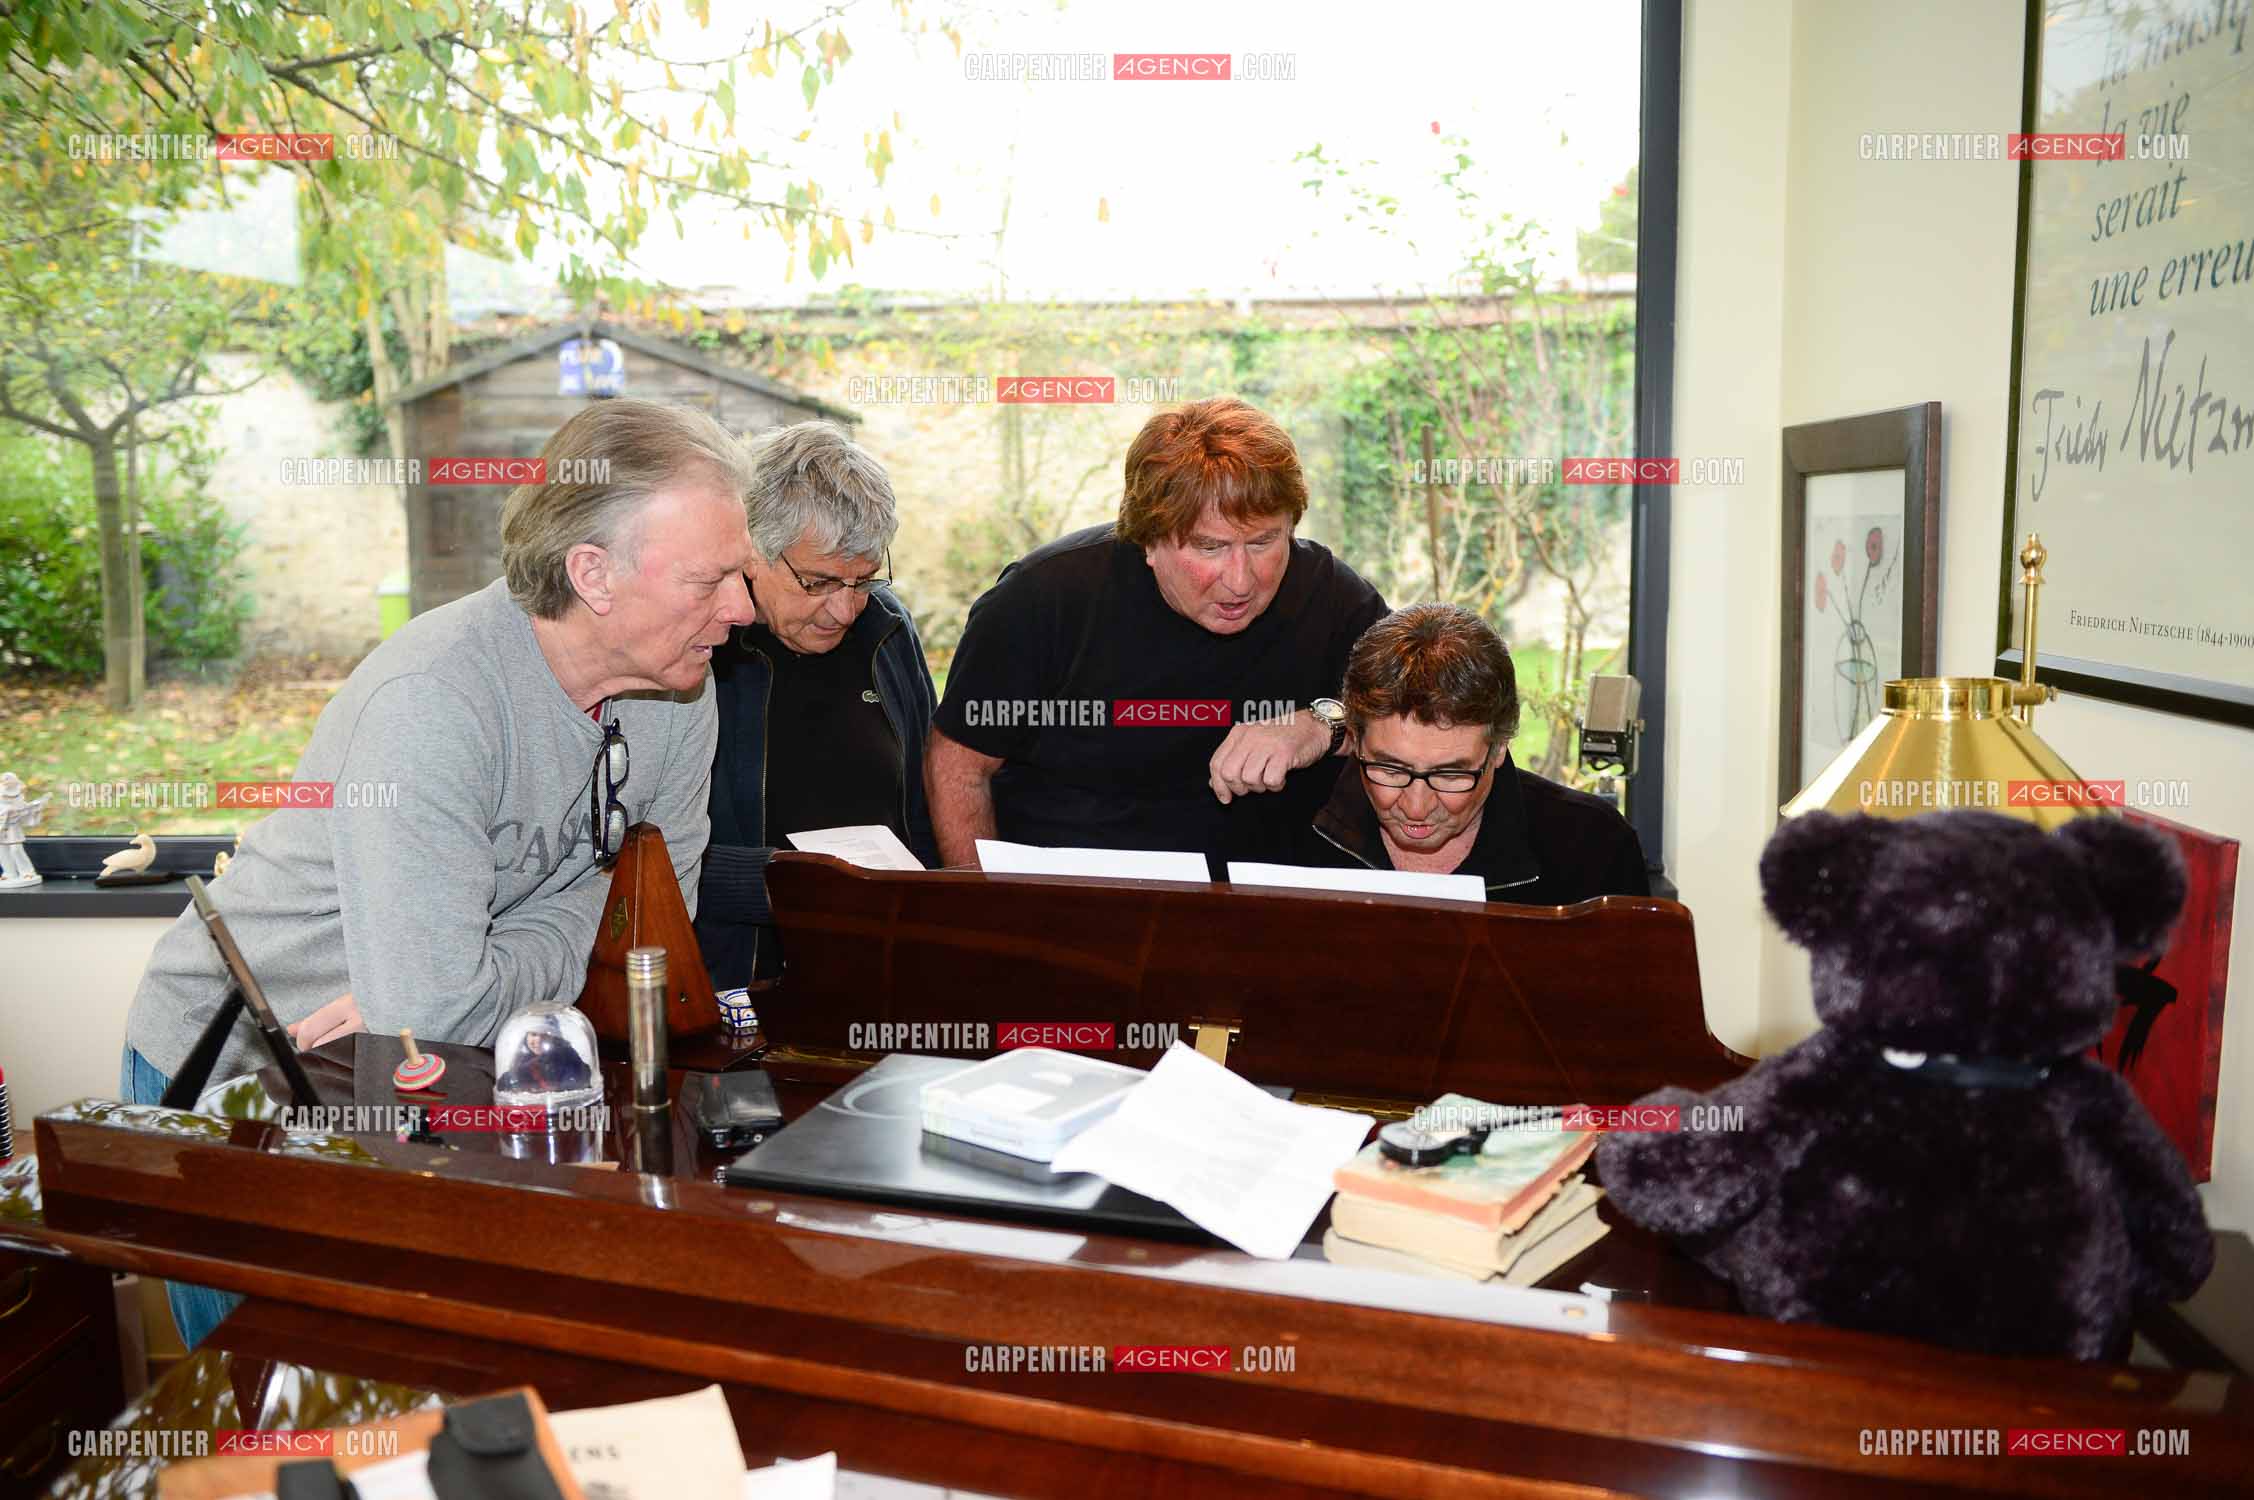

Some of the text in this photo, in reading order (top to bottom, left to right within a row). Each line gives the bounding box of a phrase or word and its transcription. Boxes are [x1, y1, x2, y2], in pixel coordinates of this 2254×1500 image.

[2091, 161, 2188, 242] serait
[2090, 265, 2149, 316] une
[2070, 608, 2126, 633] FRIEDRICH
[2129, 616, 2194, 641] NIETZSCHE
